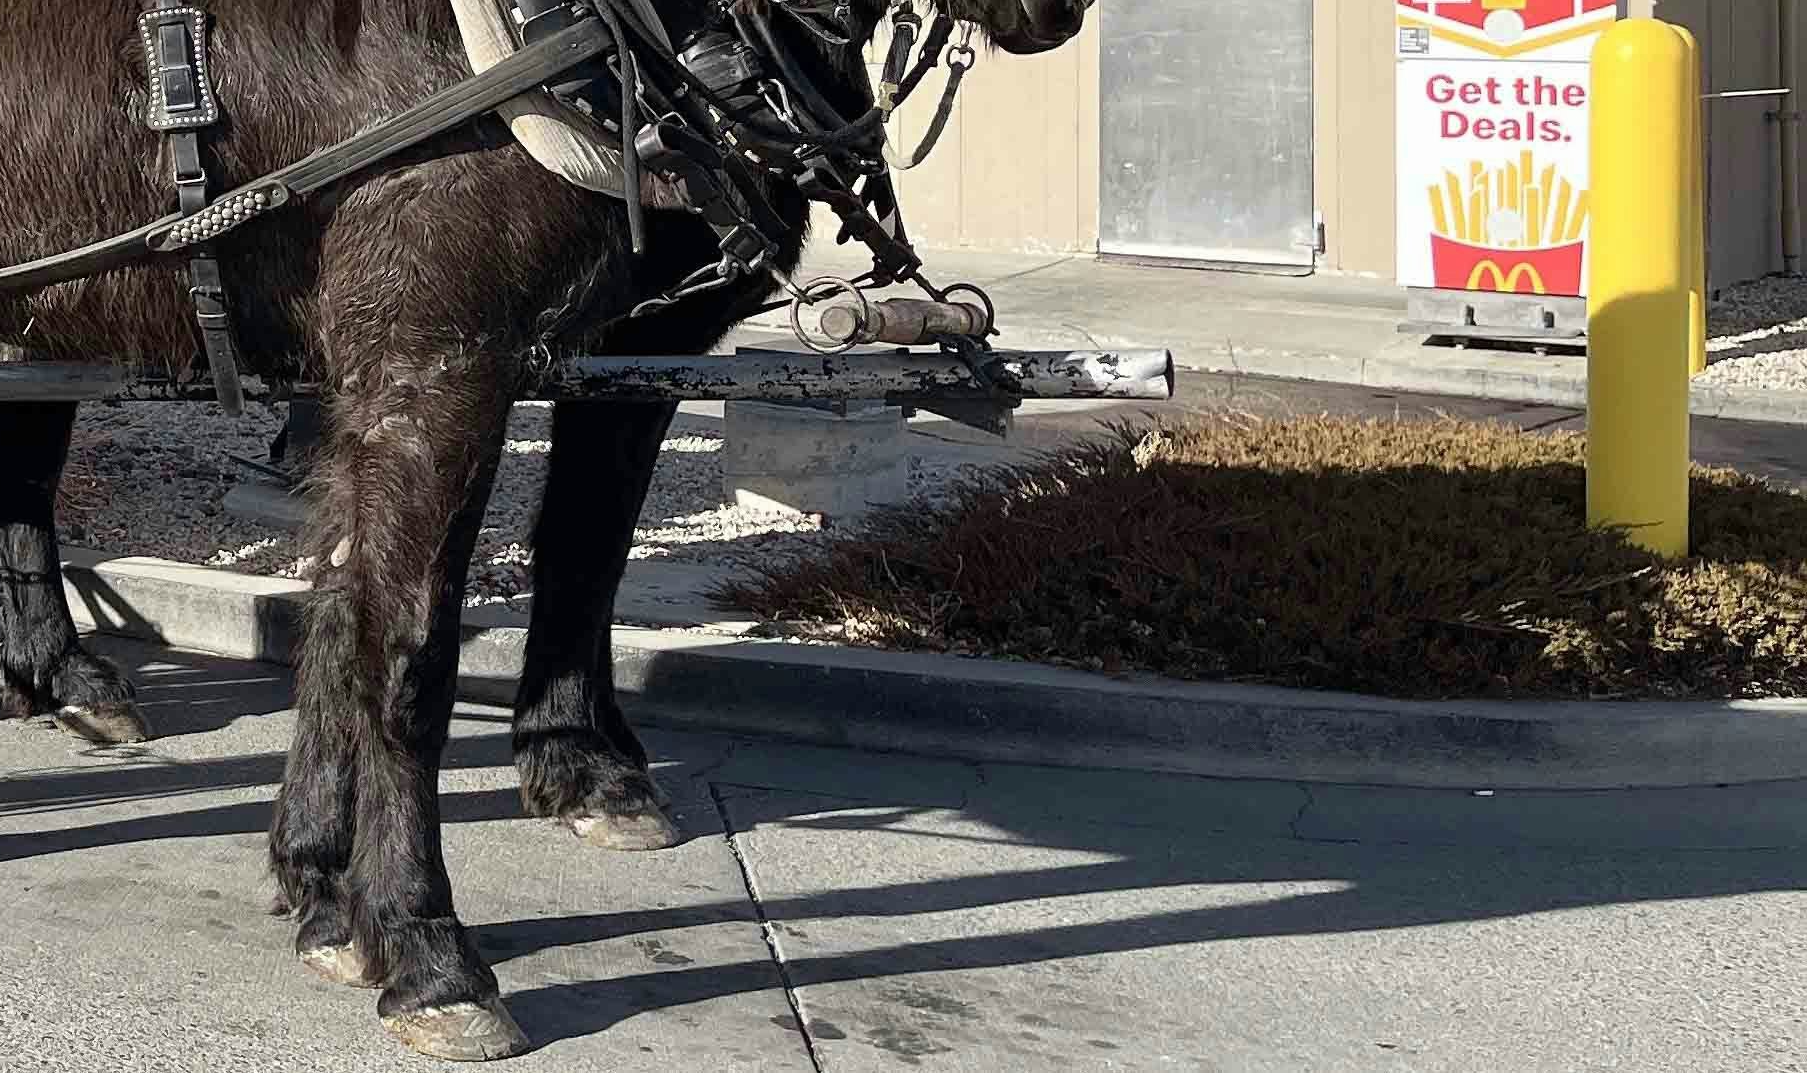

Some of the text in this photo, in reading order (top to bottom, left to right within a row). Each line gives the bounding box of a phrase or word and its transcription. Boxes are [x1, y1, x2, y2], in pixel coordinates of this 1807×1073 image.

[1425, 75, 1586, 107] Get the
[1440, 110, 1572, 143] Deals.
